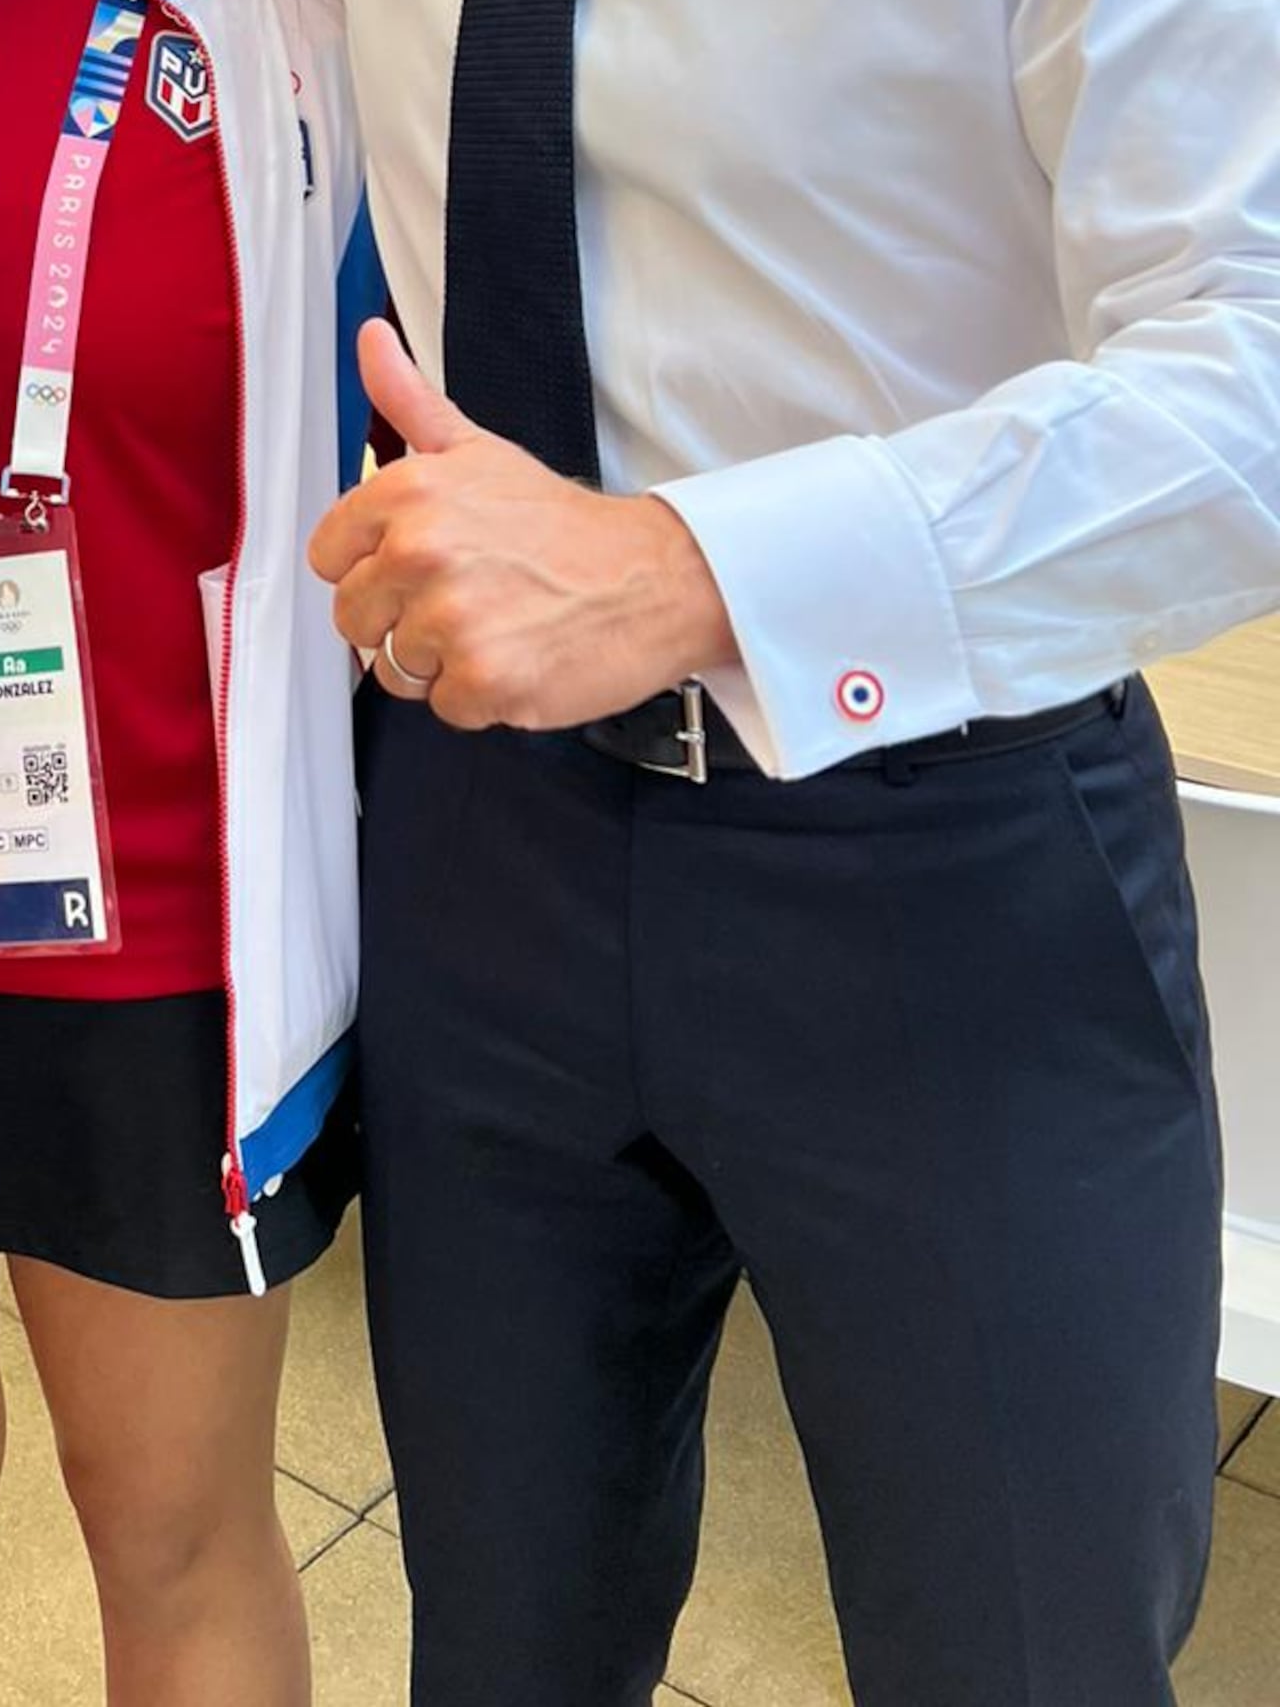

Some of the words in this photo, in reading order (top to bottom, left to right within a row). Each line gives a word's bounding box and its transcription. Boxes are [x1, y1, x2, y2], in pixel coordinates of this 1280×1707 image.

[160, 46, 207, 95] PU
[53, 152, 92, 251] PARIS
[40, 262, 71, 356] 2024
[14, 834, 45, 848] MPC
[63, 892, 90, 929] R
